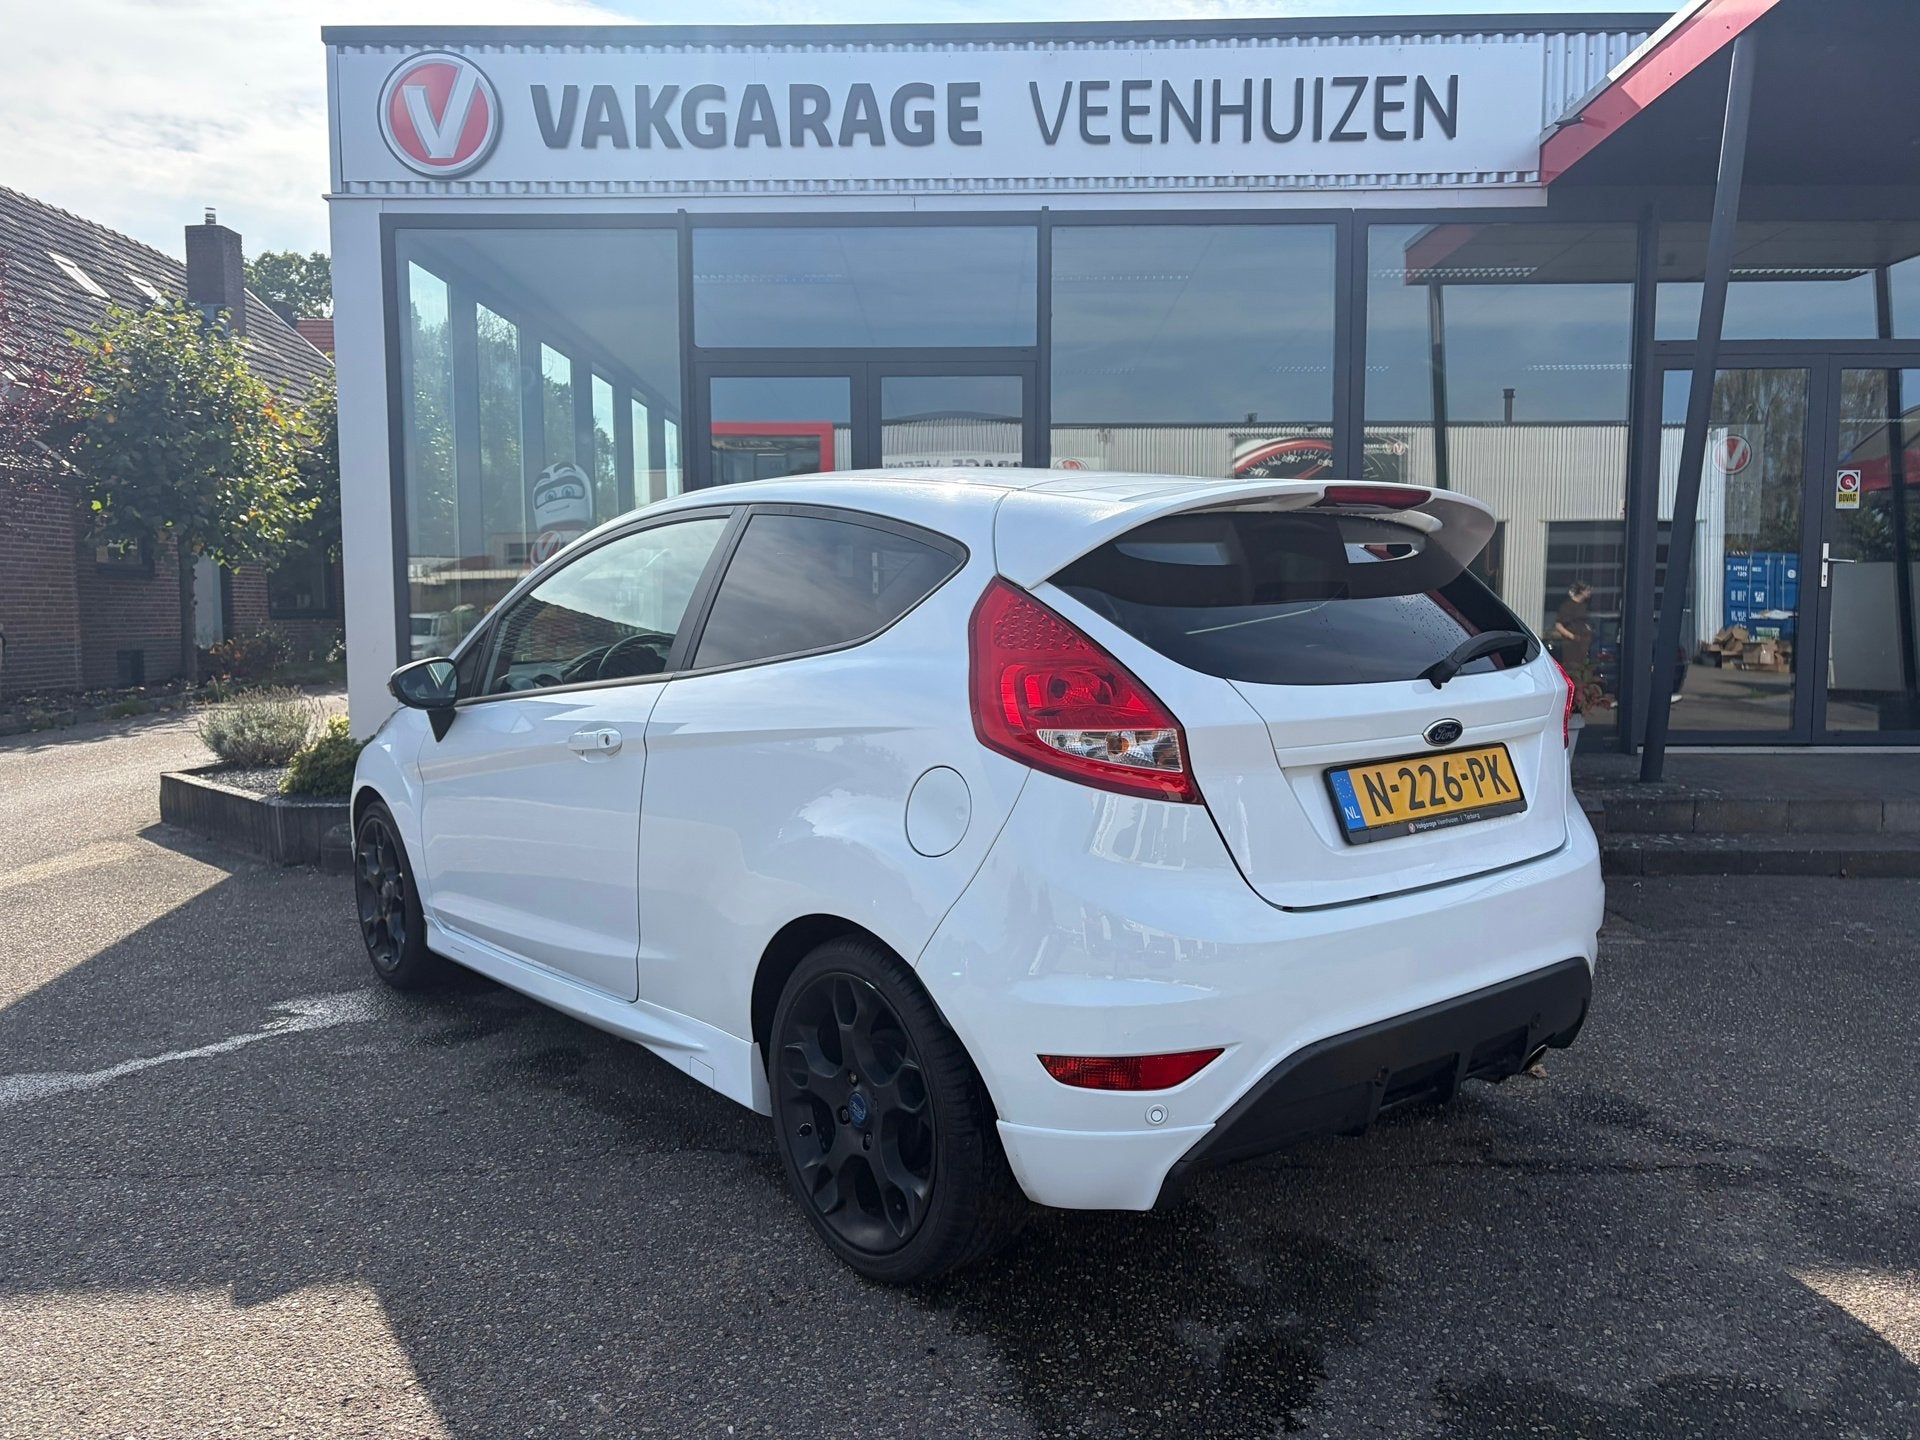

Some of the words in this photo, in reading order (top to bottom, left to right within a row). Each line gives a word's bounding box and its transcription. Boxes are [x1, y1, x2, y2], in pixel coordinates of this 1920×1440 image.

[530, 81, 983, 149] VAKGARAGE
[1029, 74, 1459, 145] VEENHUIZEN
[1838, 493, 1857, 502] BOVAG
[1434, 724, 1458, 741] Ford
[1362, 754, 1511, 817] N-226-PK
[1344, 806, 1360, 820] NL
